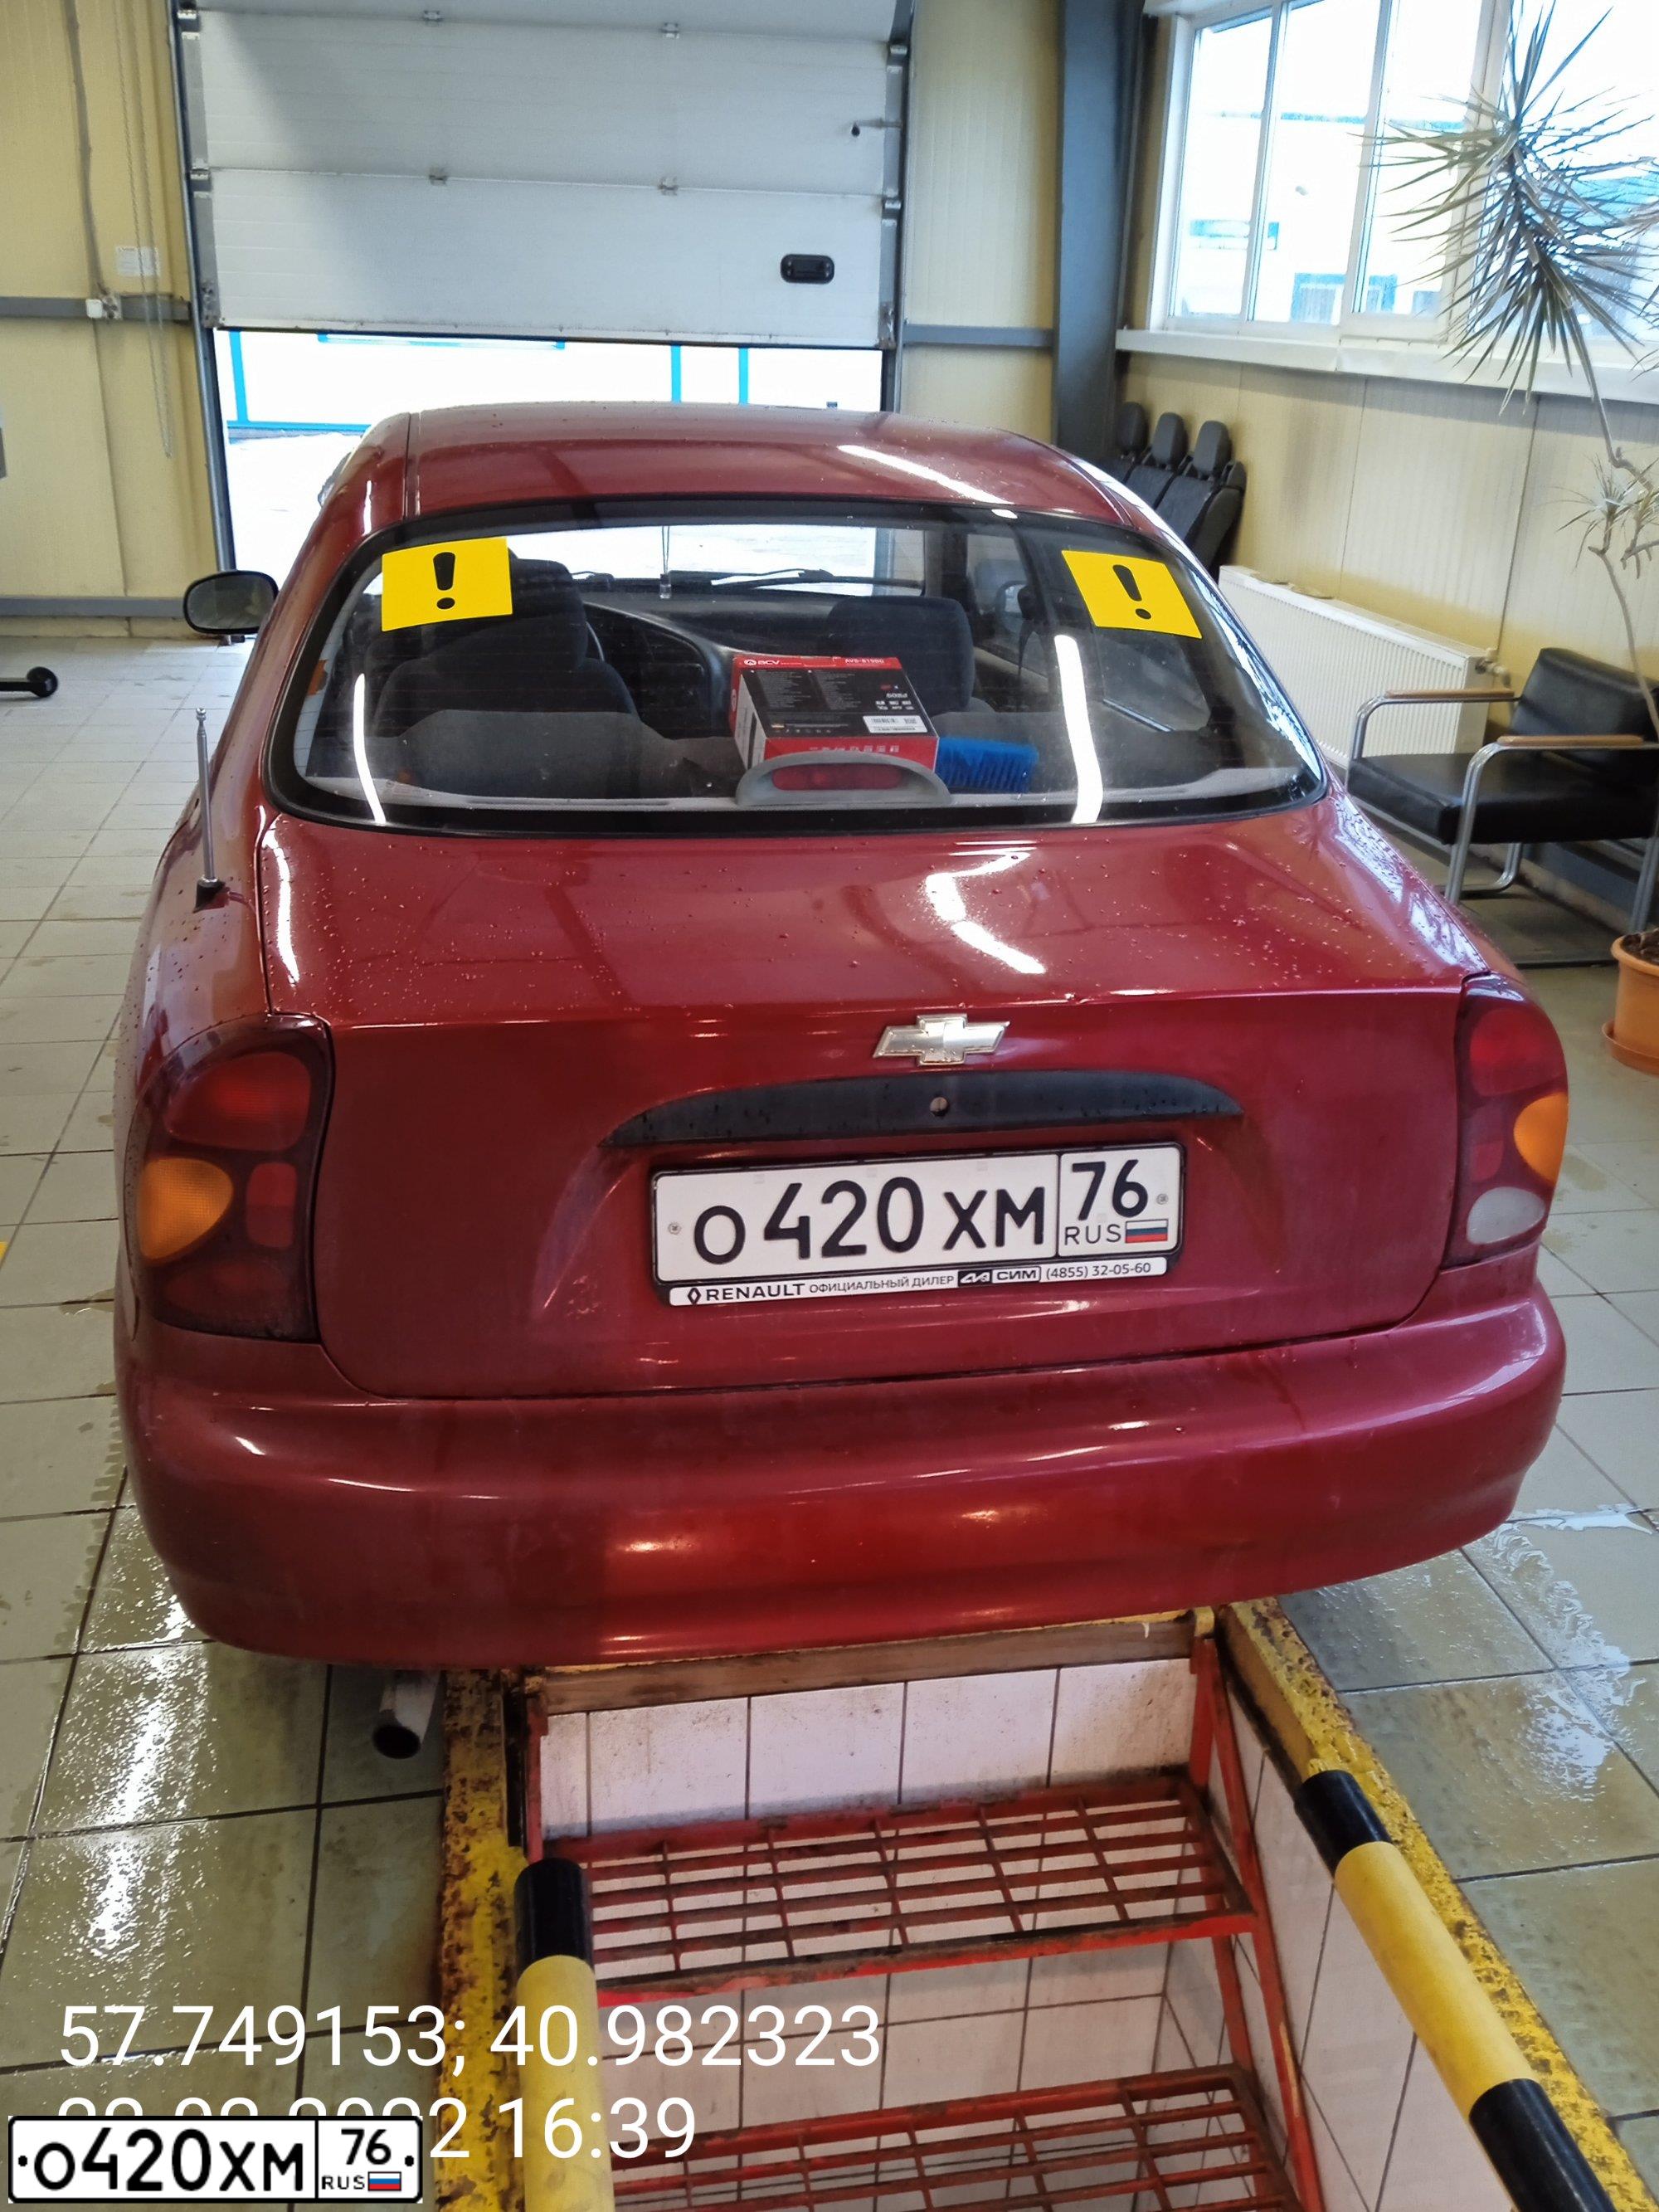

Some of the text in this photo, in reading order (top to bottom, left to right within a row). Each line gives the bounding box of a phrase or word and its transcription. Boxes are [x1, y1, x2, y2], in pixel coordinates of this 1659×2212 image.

[1071, 1158, 1149, 1221] 76
[1064, 1223, 1122, 1245] RUS
[706, 1262, 1151, 1302] RENAULT ОФИЦИАЛЬНЫЙ ДИЛЕР СИМ (4855) 32-05-60
